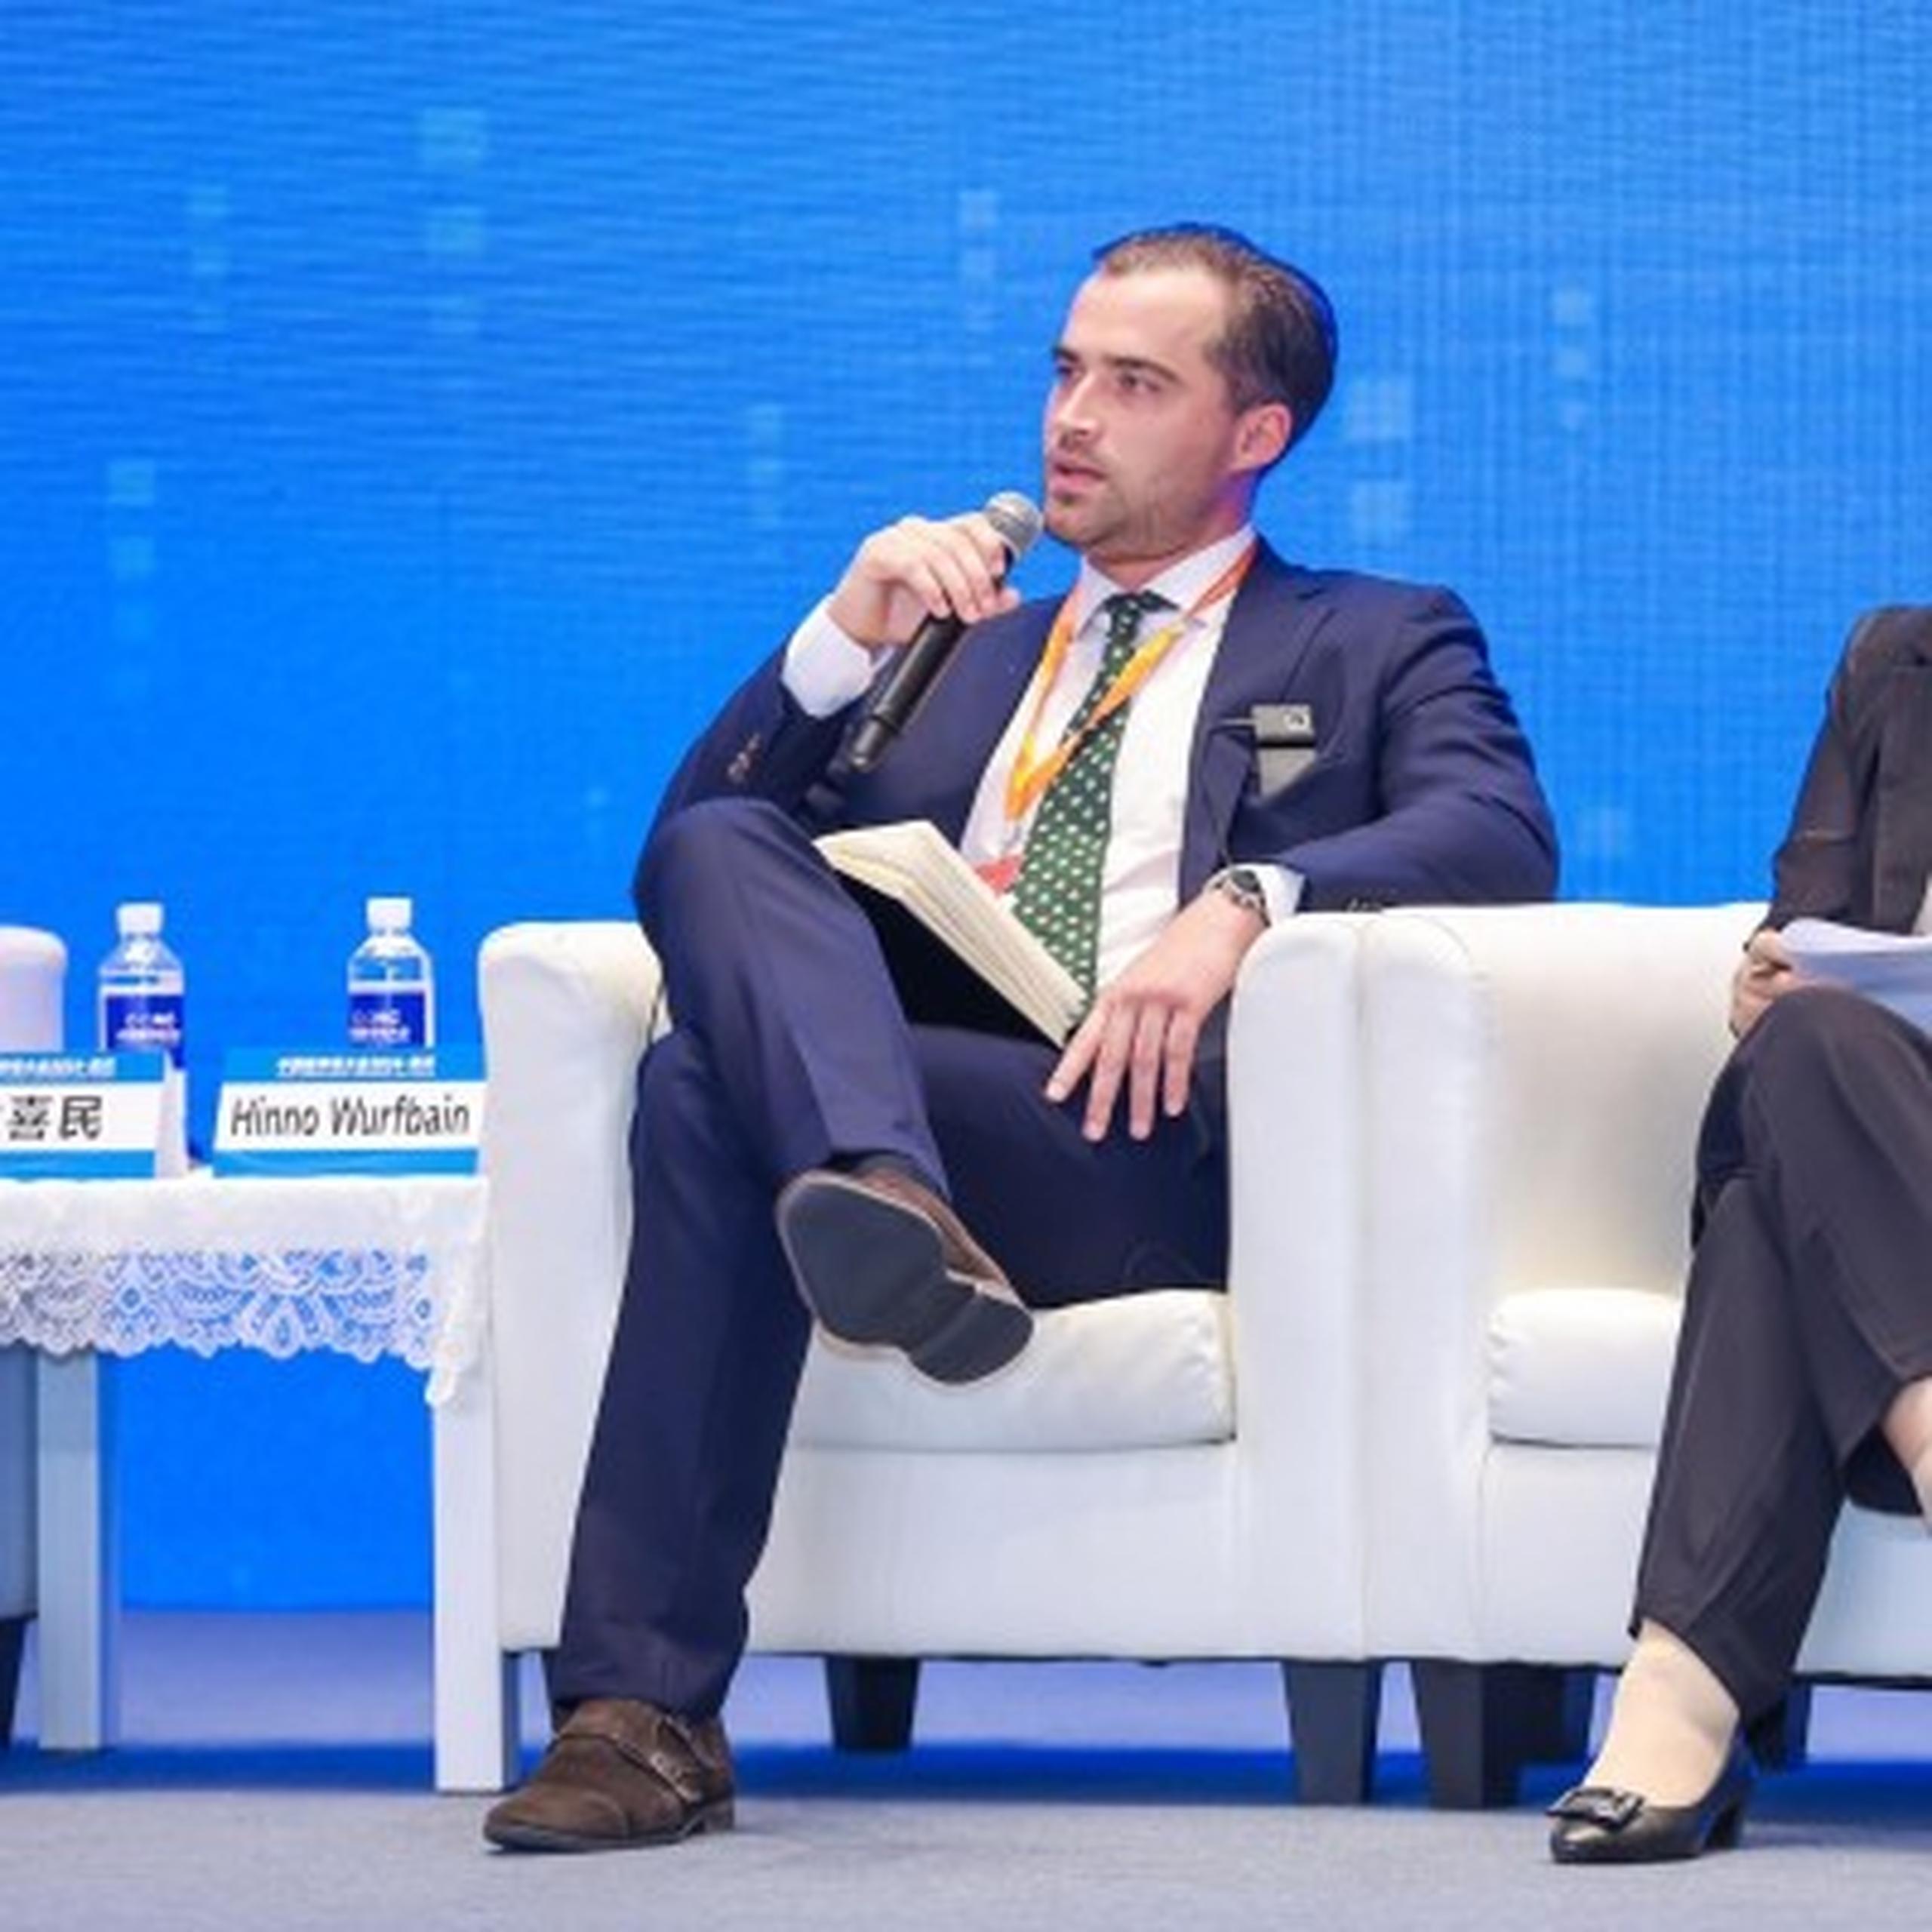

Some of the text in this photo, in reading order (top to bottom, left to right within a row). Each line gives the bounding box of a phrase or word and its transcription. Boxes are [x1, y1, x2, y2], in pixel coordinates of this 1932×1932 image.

[0, 1094, 103, 1140] 喜民
[230, 1094, 470, 1136] Hinno Wurfbain
